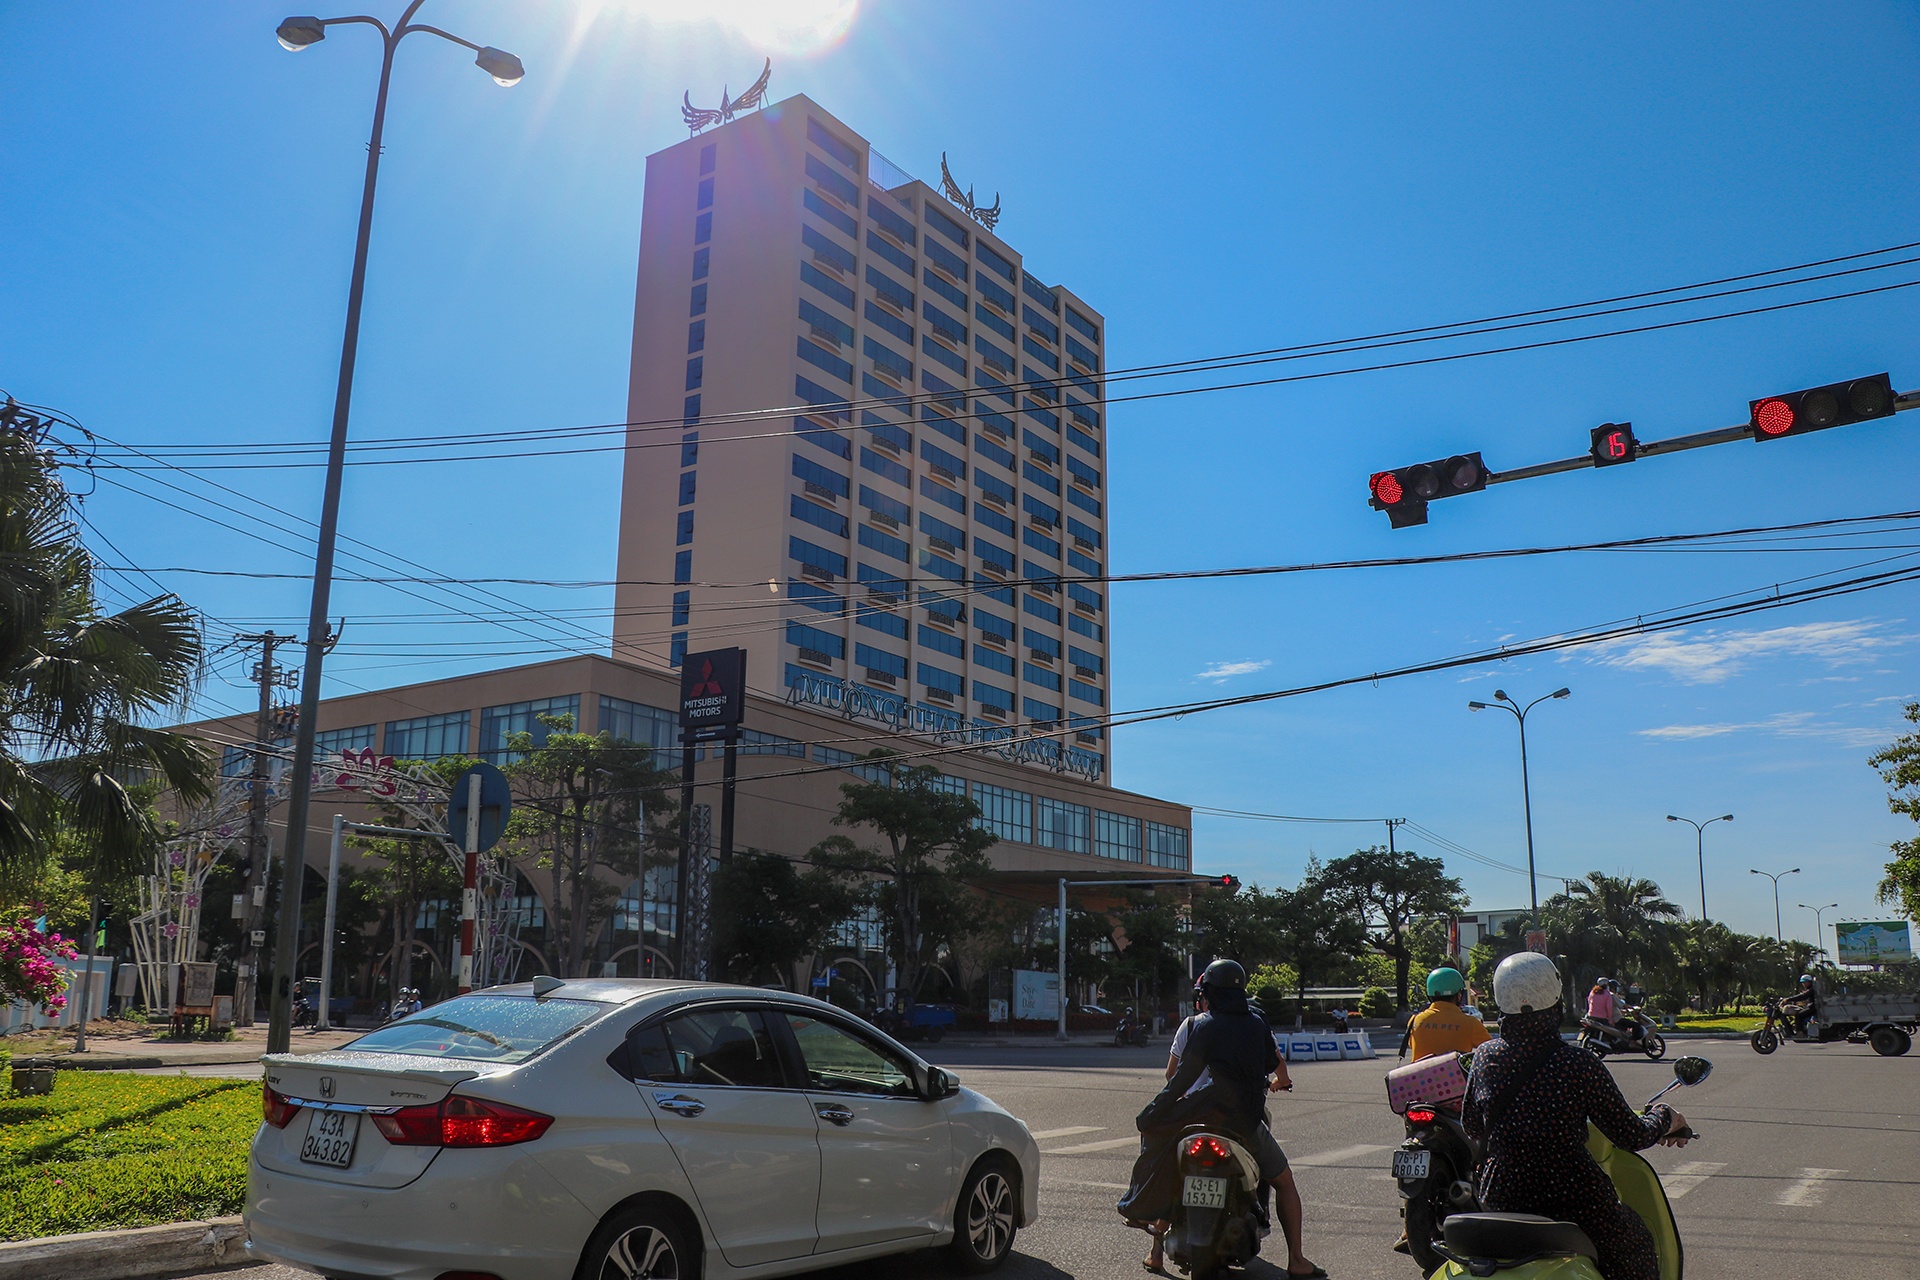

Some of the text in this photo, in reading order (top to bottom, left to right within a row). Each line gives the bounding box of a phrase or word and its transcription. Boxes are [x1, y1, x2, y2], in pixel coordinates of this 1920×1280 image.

[1608, 432, 1626, 457] 15
[684, 696, 727, 709] MITSUBISHI
[689, 707, 721, 718] MOTORS
[904, 702, 983, 745] THANH
[319, 1114, 346, 1137] 43A
[303, 1136, 350, 1164] 343.82
[1187, 1192, 1222, 1206] 153.77
